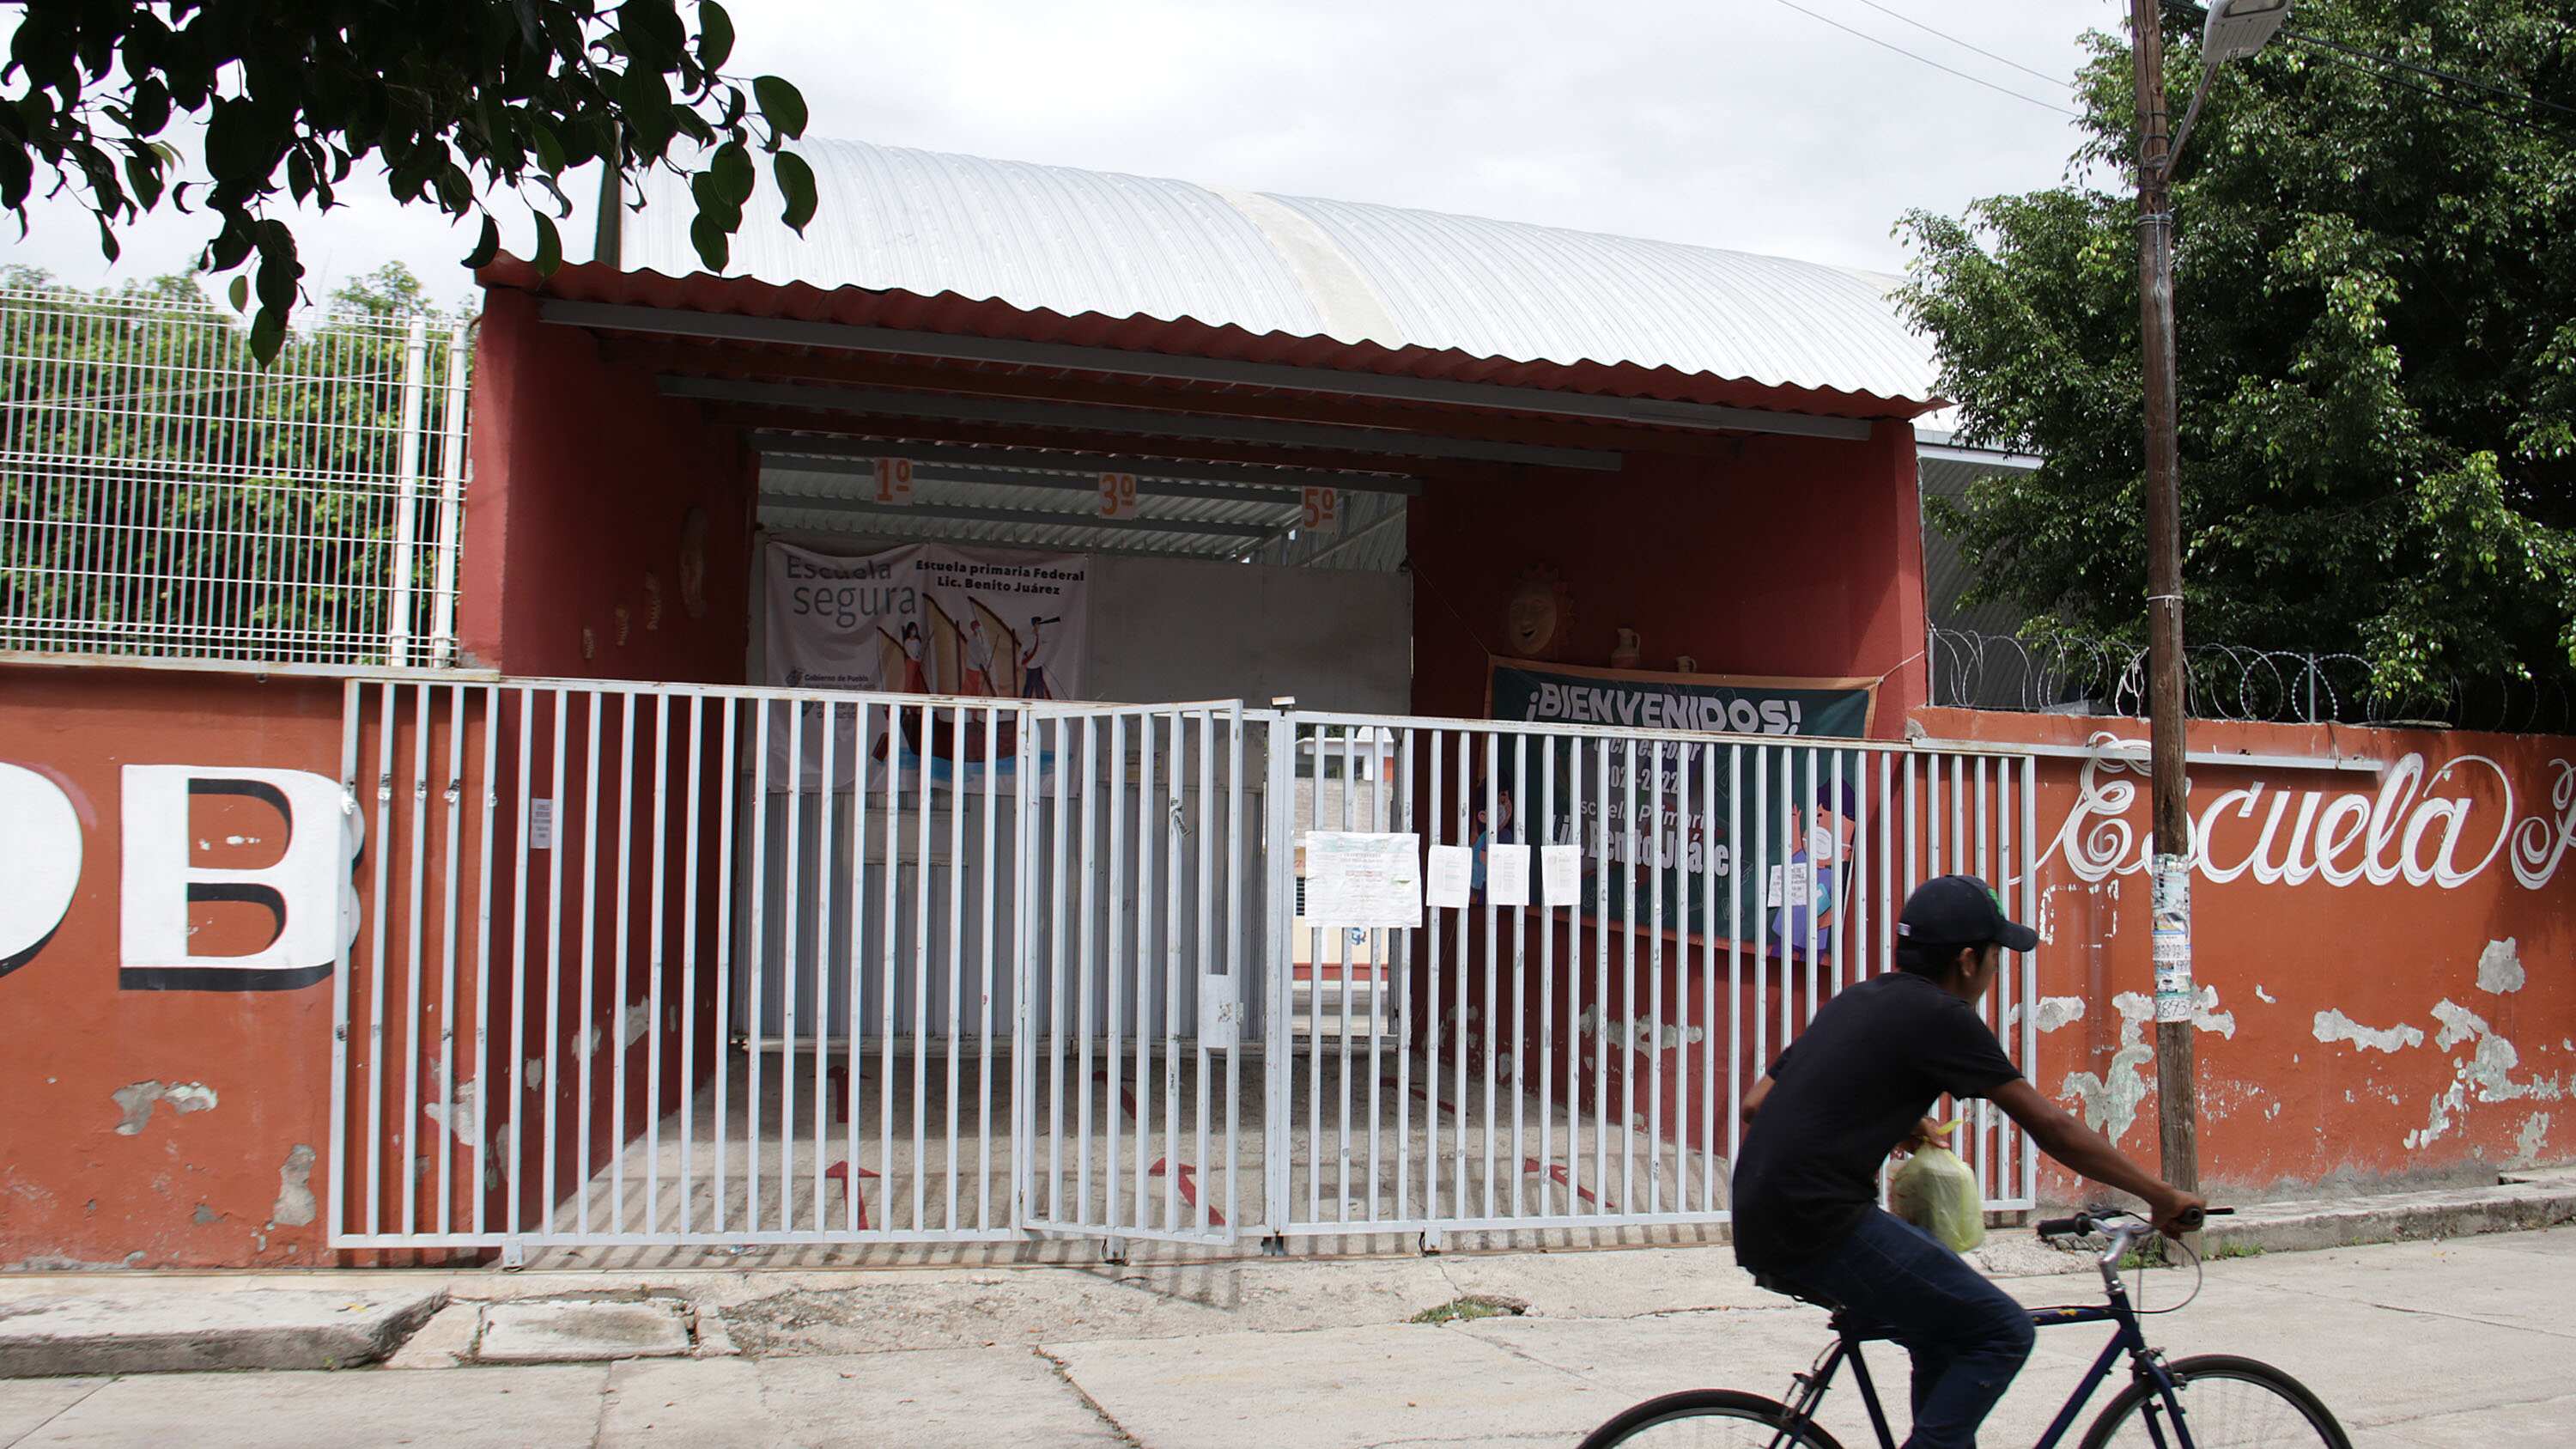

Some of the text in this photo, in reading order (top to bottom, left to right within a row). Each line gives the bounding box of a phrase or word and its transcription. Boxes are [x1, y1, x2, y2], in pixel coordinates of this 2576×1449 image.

[787, 557, 891, 580] Escuela
[915, 560, 1084, 581] Escuela primaria Federal
[937, 576, 1060, 595] Lic. Benito Juárez
[793, 586, 916, 629] segura
[1526, 682, 1801, 736] ¡BIENVENIDOS!
